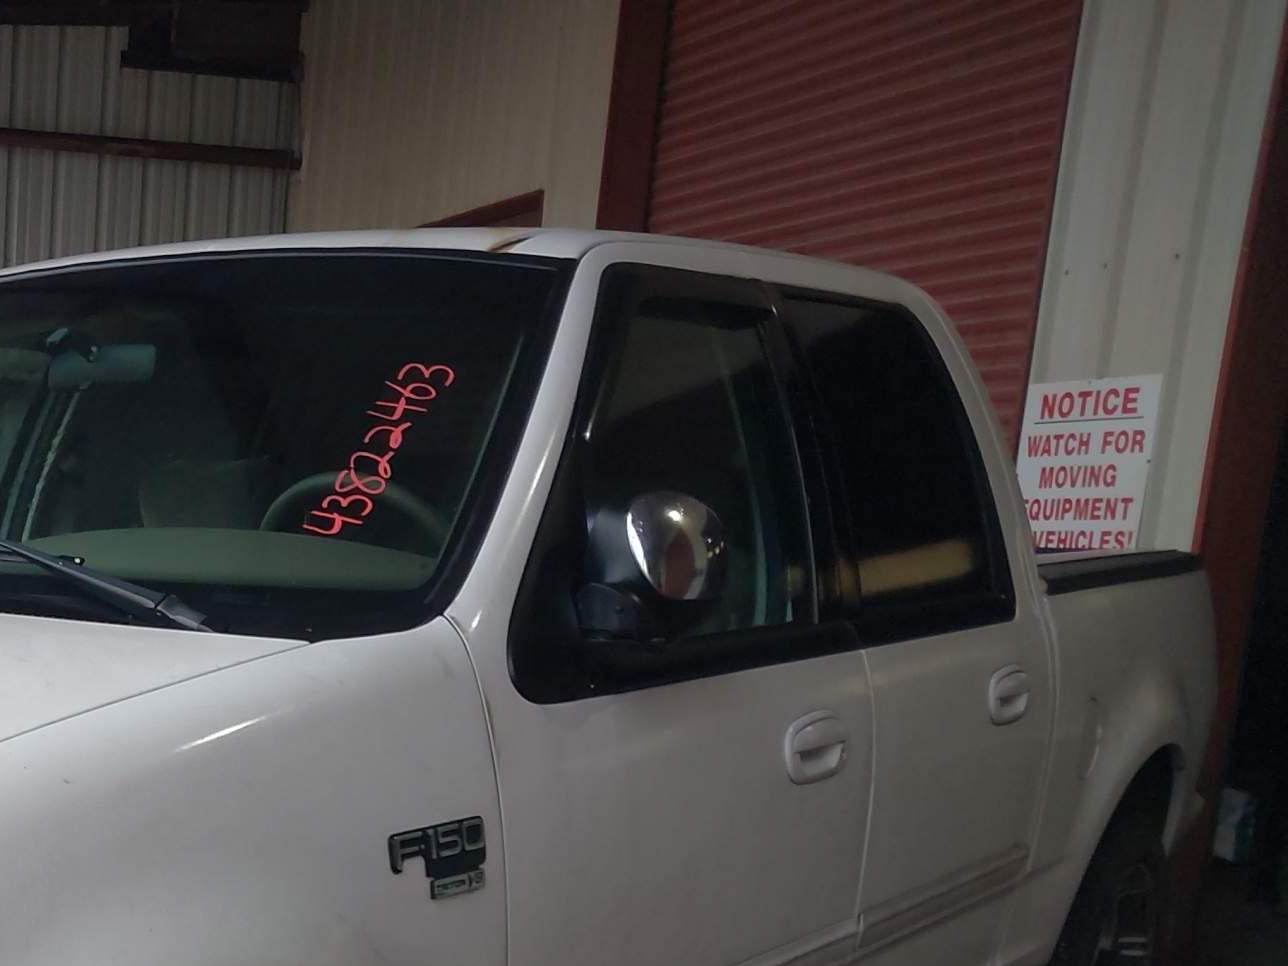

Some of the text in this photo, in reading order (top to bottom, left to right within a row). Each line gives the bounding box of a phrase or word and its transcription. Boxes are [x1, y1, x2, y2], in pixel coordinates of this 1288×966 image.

[1040, 387, 1140, 420] NOTICE
[302, 363, 455, 535] 43822463
[1028, 430, 1145, 458] WATCH FOR
[1038, 464, 1117, 488] MOVING
